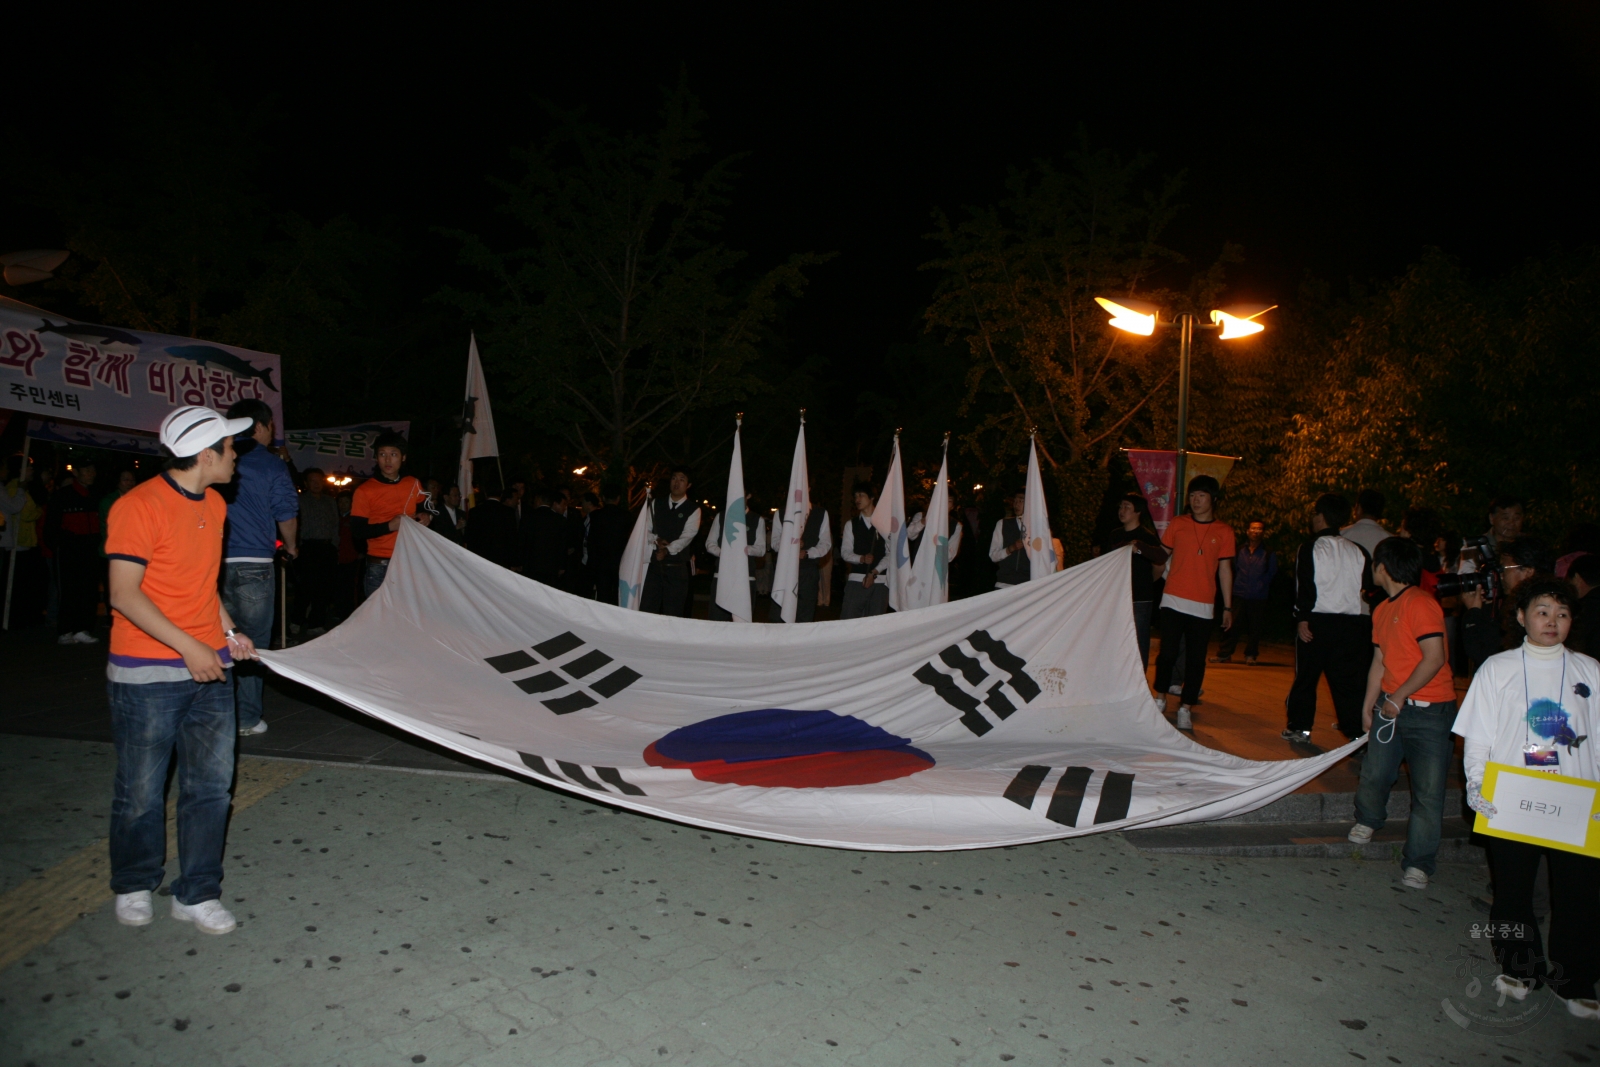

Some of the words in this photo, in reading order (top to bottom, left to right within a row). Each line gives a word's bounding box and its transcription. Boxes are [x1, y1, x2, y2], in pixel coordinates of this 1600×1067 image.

[0, 331, 44, 377] 와
[64, 342, 135, 395] 함께
[149, 362, 262, 409] 비상한다
[10, 383, 81, 411] 주민센터
[288, 432, 377, 459] 푸른울
[1519, 799, 1561, 817] 태극기
